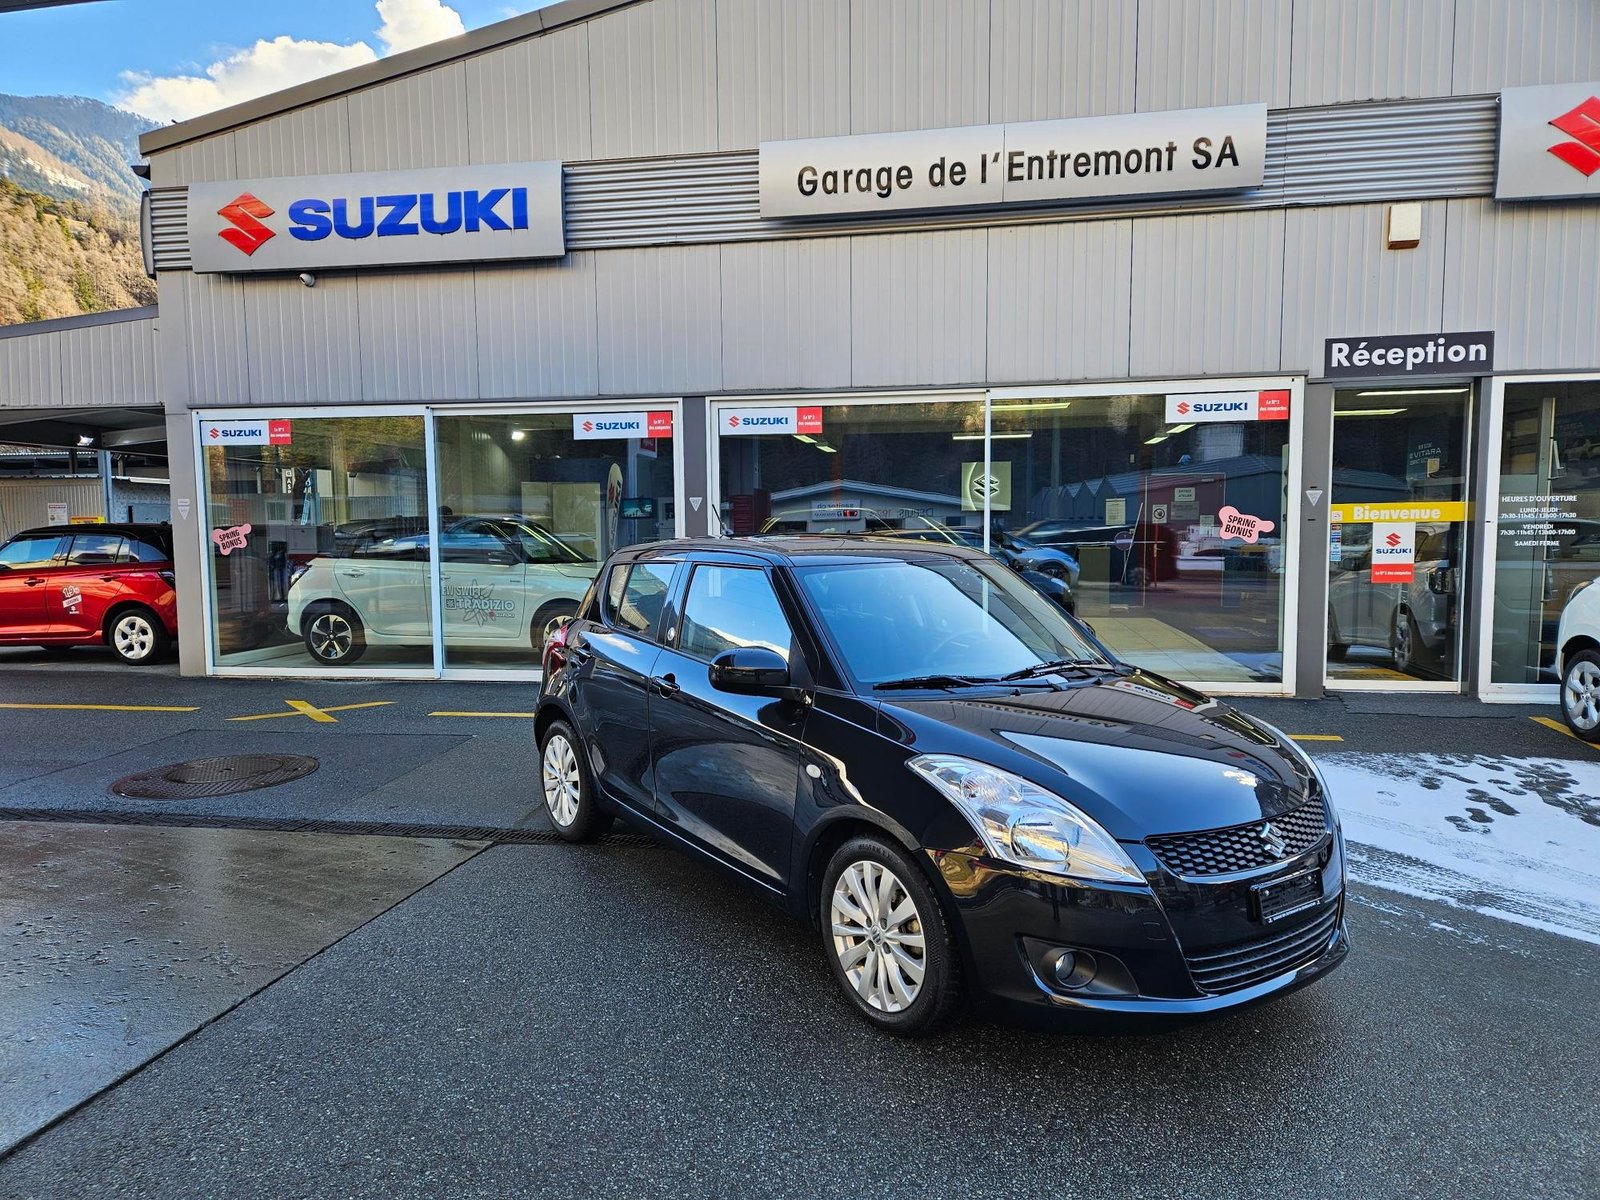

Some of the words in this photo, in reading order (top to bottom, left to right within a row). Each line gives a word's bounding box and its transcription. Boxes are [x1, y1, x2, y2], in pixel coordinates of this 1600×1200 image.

[798, 161, 913, 199] Garage
[928, 156, 966, 187] de
[980, 140, 1177, 184] l'Entremont
[1192, 135, 1240, 169] SA
[288, 187, 528, 242] SUZUKI
[1331, 337, 1487, 371] Réception
[1193, 402, 1248, 412] SUZUKI
[596, 421, 640, 431] SUZUKI
[743, 417, 788, 426] SUZUKI
[221, 429, 262, 437] SUZUKI
[1353, 505, 1441, 520] Bienvenue
[1227, 514, 1256, 529] SPRING
[218, 529, 240, 542] SPRING
[1225, 523, 1253, 538] BONUS
[221, 536, 243, 550] BONUS
[457, 598, 515, 611] TRADIZIO
